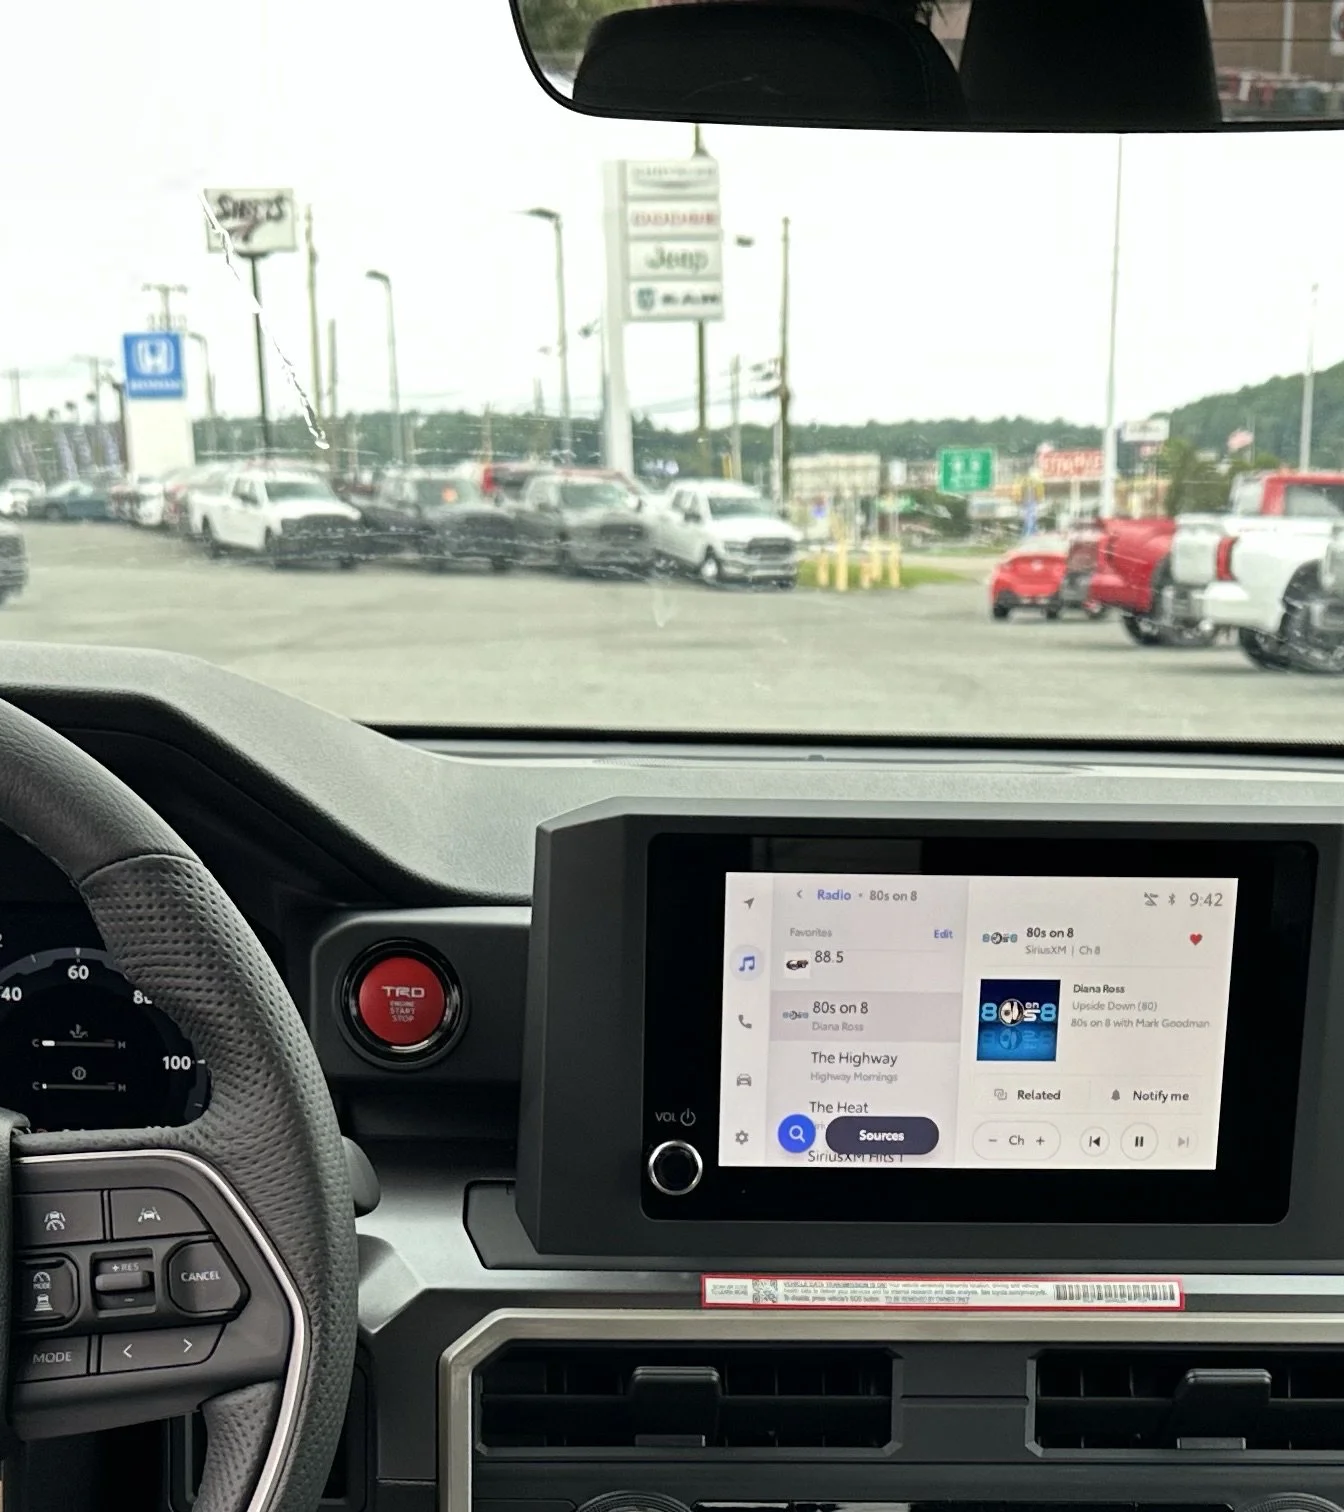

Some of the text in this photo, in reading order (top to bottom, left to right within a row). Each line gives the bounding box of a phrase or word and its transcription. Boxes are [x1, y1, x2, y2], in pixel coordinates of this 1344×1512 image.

[816, 888, 918, 902] Radio 80s on 8
[1188, 892, 1224, 908] 9:42
[789, 927, 954, 940] Favorites Edit
[1025, 927, 1047, 939] 80s
[1049, 929, 1066, 939] on
[1066, 927, 1075, 939] 8
[1024, 944, 1101, 956] SiriusXM Ch 8
[813, 950, 845, 965] 88.5
[66, 964, 90, 981] 60
[0, 985, 23, 1002] 40
[380, 985, 426, 999] TRD
[1072, 983, 1126, 995] Diana Ross
[389, 1007, 416, 1016] START
[811, 1000, 837, 1015] 80s
[838, 1003, 858, 1015] on
[859, 1001, 869, 1015] 8
[1071, 1000, 1158, 1013] Upside Down (80)
[811, 1021, 865, 1033] Diana Ross
[1070, 1018, 1088, 1029] 80s
[1089, 1020, 1103, 1029] on
[1113, 1018, 1134, 1029] with
[1134, 1018, 1160, 1029] Mark
[1161, 1018, 1211, 1030] Goodman
[161, 1054, 192, 1071] 100
[810, 1051, 899, 1068] The Highway
[809, 1071, 852, 1084] Highway
[1016, 1089, 1062, 1101] Related
[1132, 1090, 1190, 1104] Notify me
[808, 1100, 869, 1115] The Heat
[655, 1111, 677, 1123] VOL
[858, 1129, 906, 1142] Sources
[1008, 1134, 1026, 1147] Ch
[180, 1270, 222, 1283] CANCEL
[31, 1350, 73, 1365] MODE
